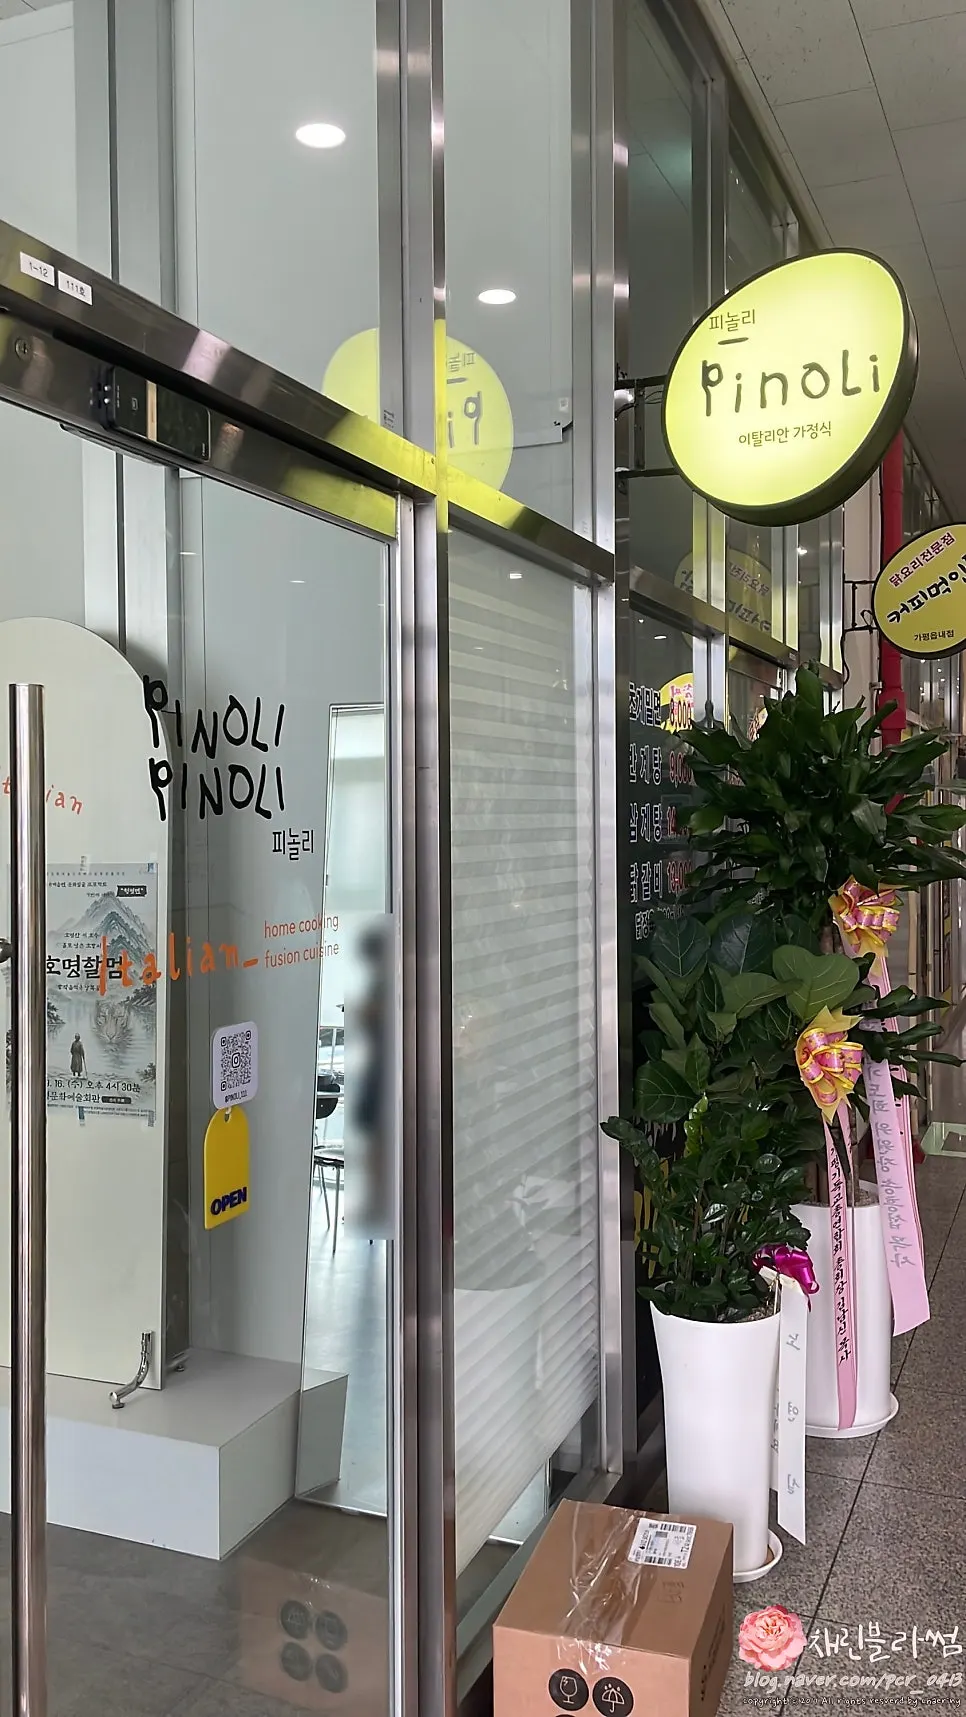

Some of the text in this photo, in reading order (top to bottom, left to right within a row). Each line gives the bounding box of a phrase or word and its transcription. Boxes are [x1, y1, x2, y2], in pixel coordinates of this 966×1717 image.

[29, 261, 48, 277] 1-12
[66, 280, 86, 297] 111호
[708, 308, 756, 332] 피놀리
[738, 420, 832, 447] 이탈리안 가정식
[889, 531, 956, 587] 닭요리전문점
[914, 629, 955, 642] 가평읍내점
[142, 674, 286, 760] PINOLI
[148, 756, 286, 822] PINOLI
[271, 827, 314, 861] 피놀리
[263, 913, 340, 939] home cooking
[263, 942, 340, 969] fusion cuisine
[85, 1080, 104, 1089] 오후
[105, 1081, 120, 1092] 4시
[121, 1082, 142, 1093] 30분
[210, 1186, 248, 1216] OPEN
